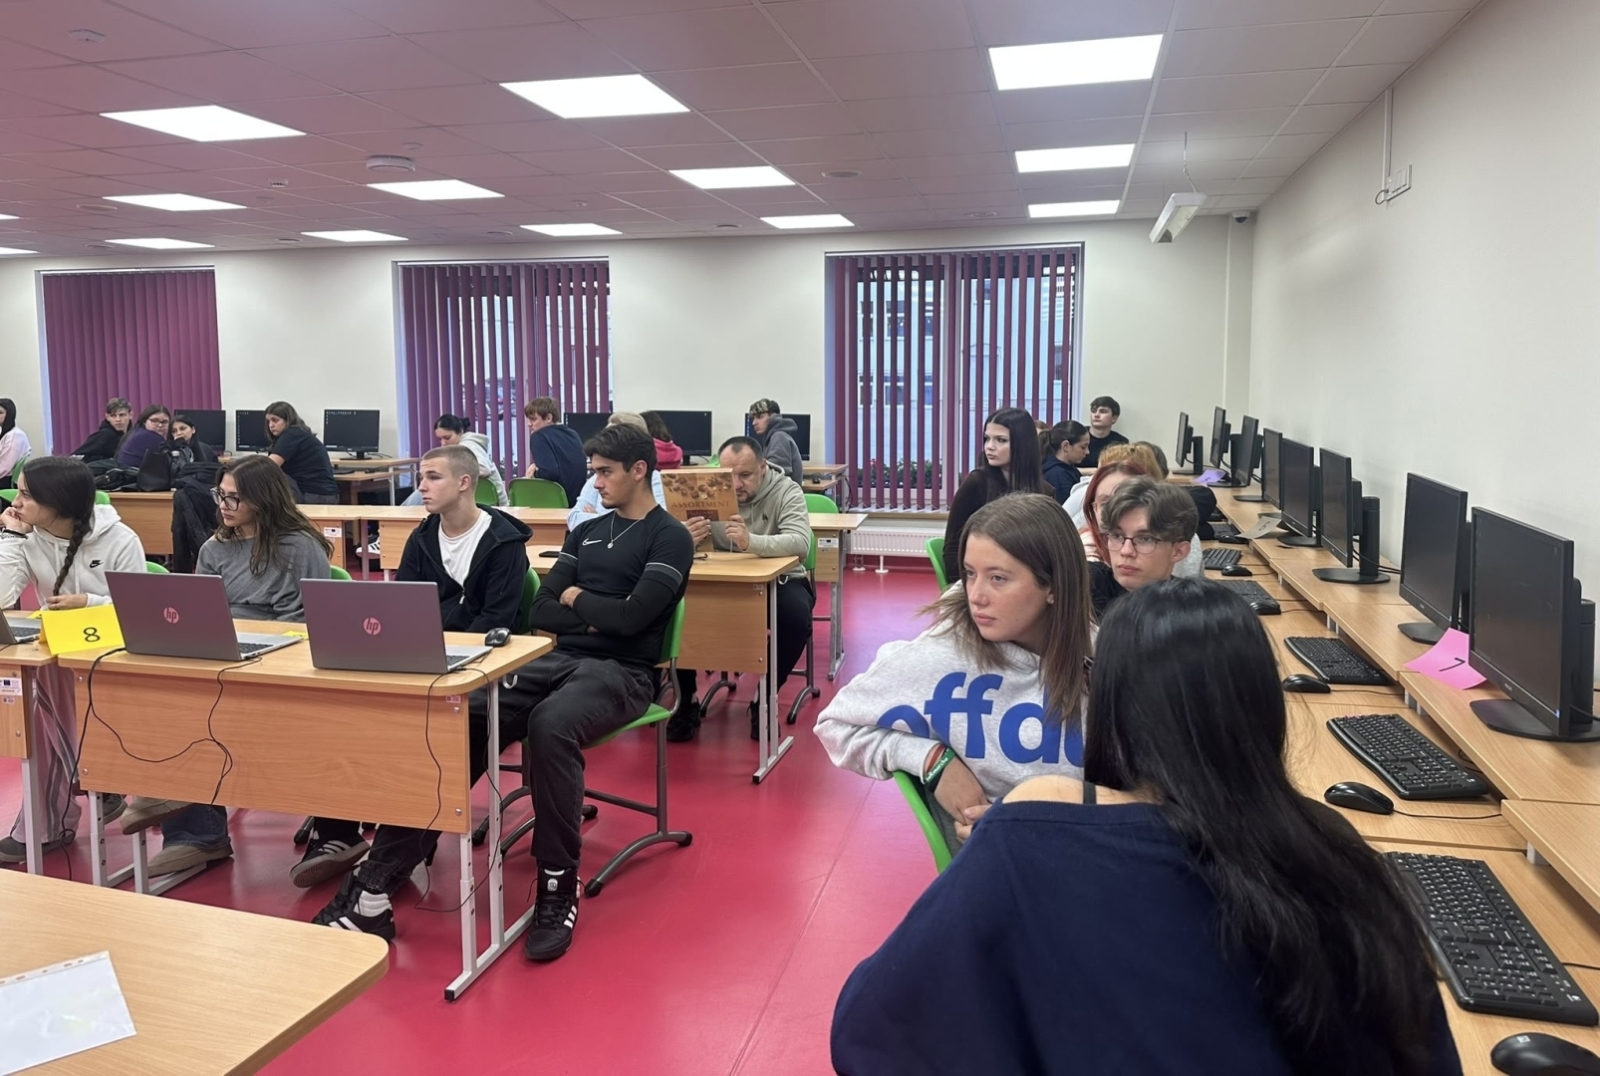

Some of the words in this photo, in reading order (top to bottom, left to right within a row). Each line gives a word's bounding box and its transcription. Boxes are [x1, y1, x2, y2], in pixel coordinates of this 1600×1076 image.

[165, 607, 178, 623] hp
[365, 617, 380, 635] hp
[83, 627, 101, 643] 8
[1438, 656, 1466, 672] 7
